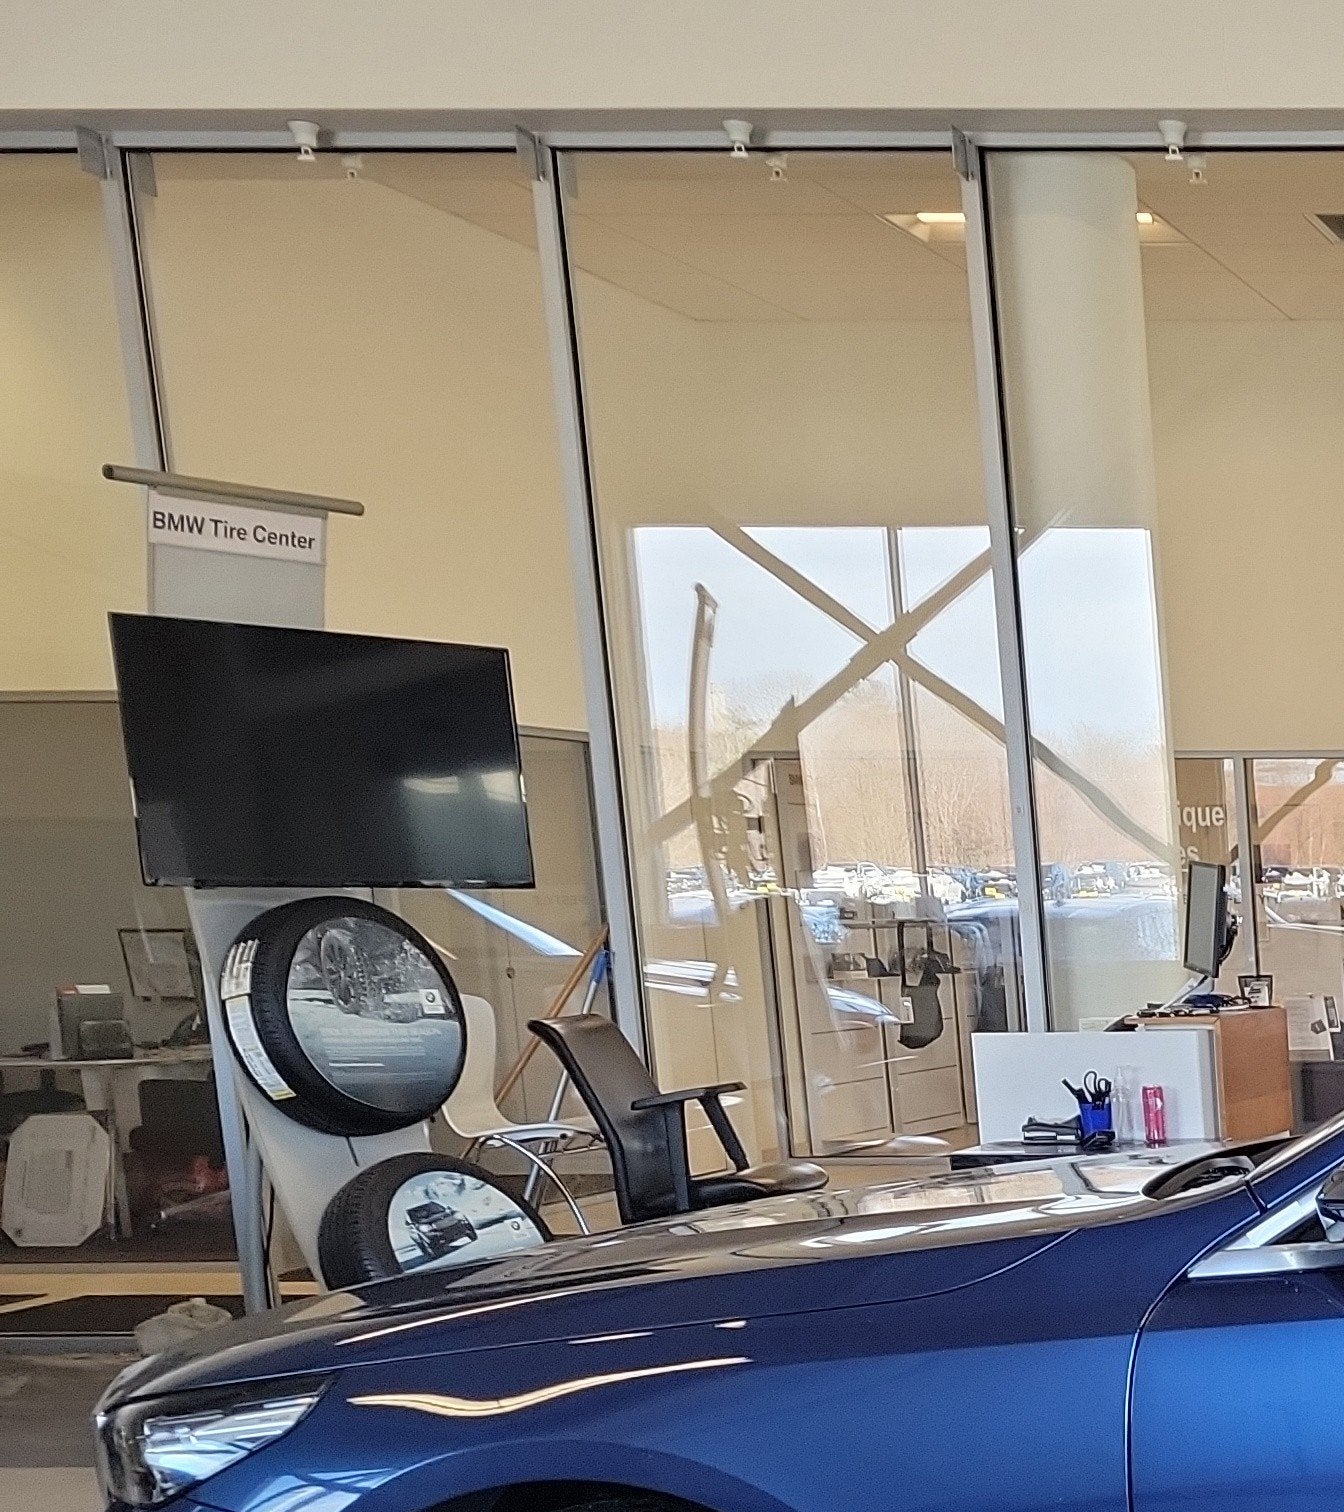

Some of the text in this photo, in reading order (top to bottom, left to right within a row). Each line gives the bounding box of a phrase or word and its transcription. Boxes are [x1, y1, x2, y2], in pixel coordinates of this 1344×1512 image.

[152, 510, 316, 550] BMW Tire Center
